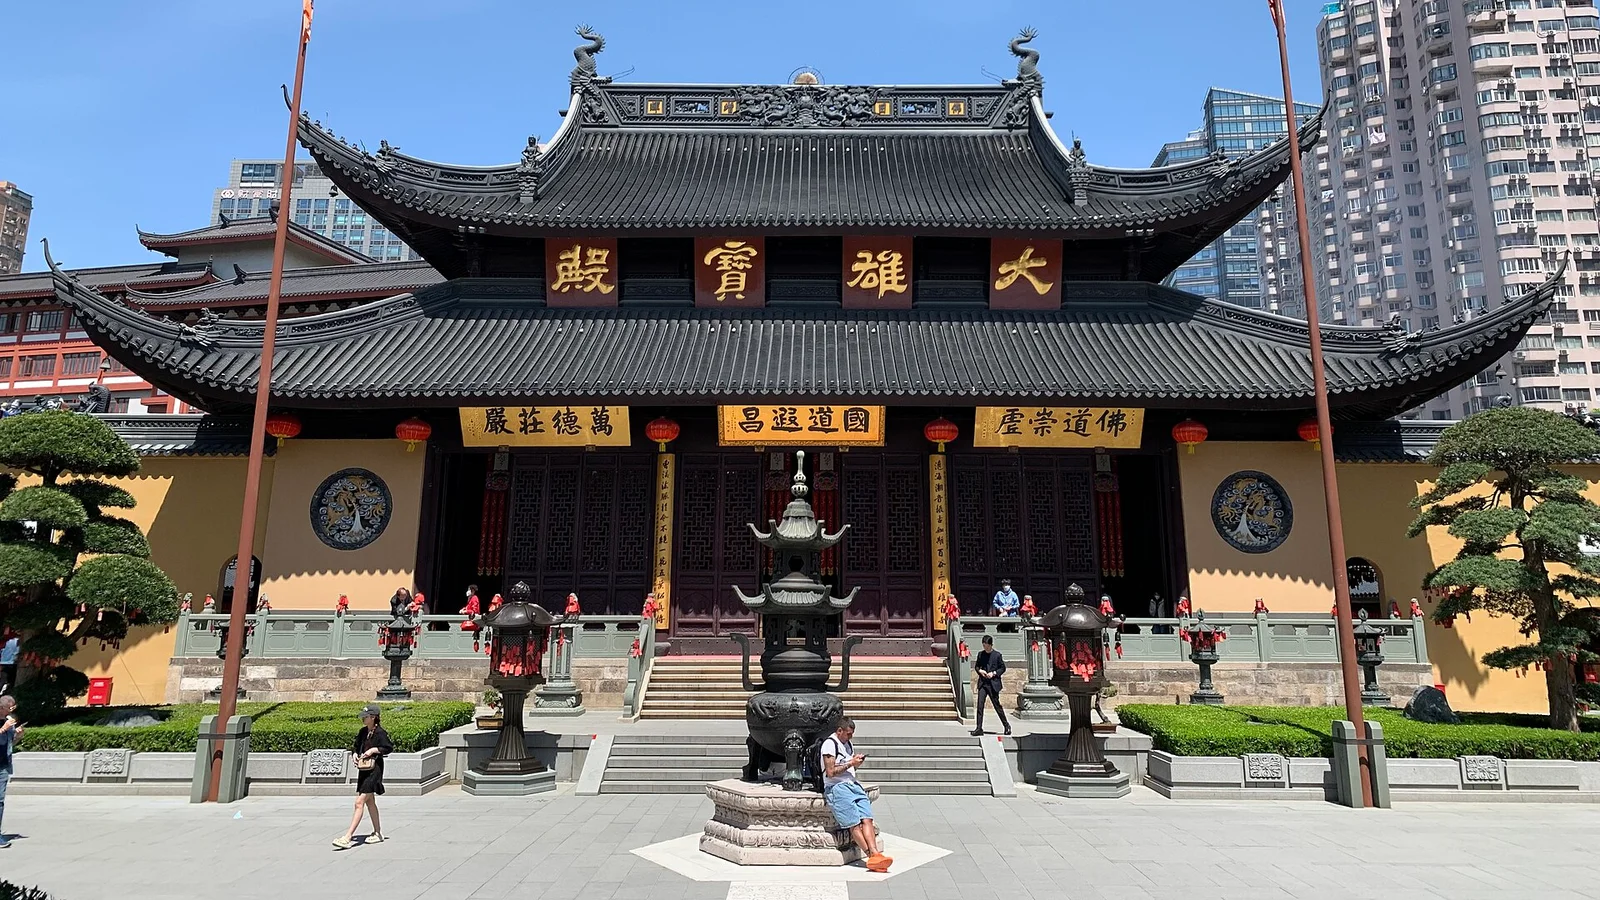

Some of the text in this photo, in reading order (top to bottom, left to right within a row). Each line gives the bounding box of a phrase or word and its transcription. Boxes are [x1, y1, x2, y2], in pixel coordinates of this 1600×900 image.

[550, 240, 1053, 302] 大雄寶殿
[483, 406, 614, 436] 萬德莊嚴
[738, 406, 870, 434] 國道遐昌
